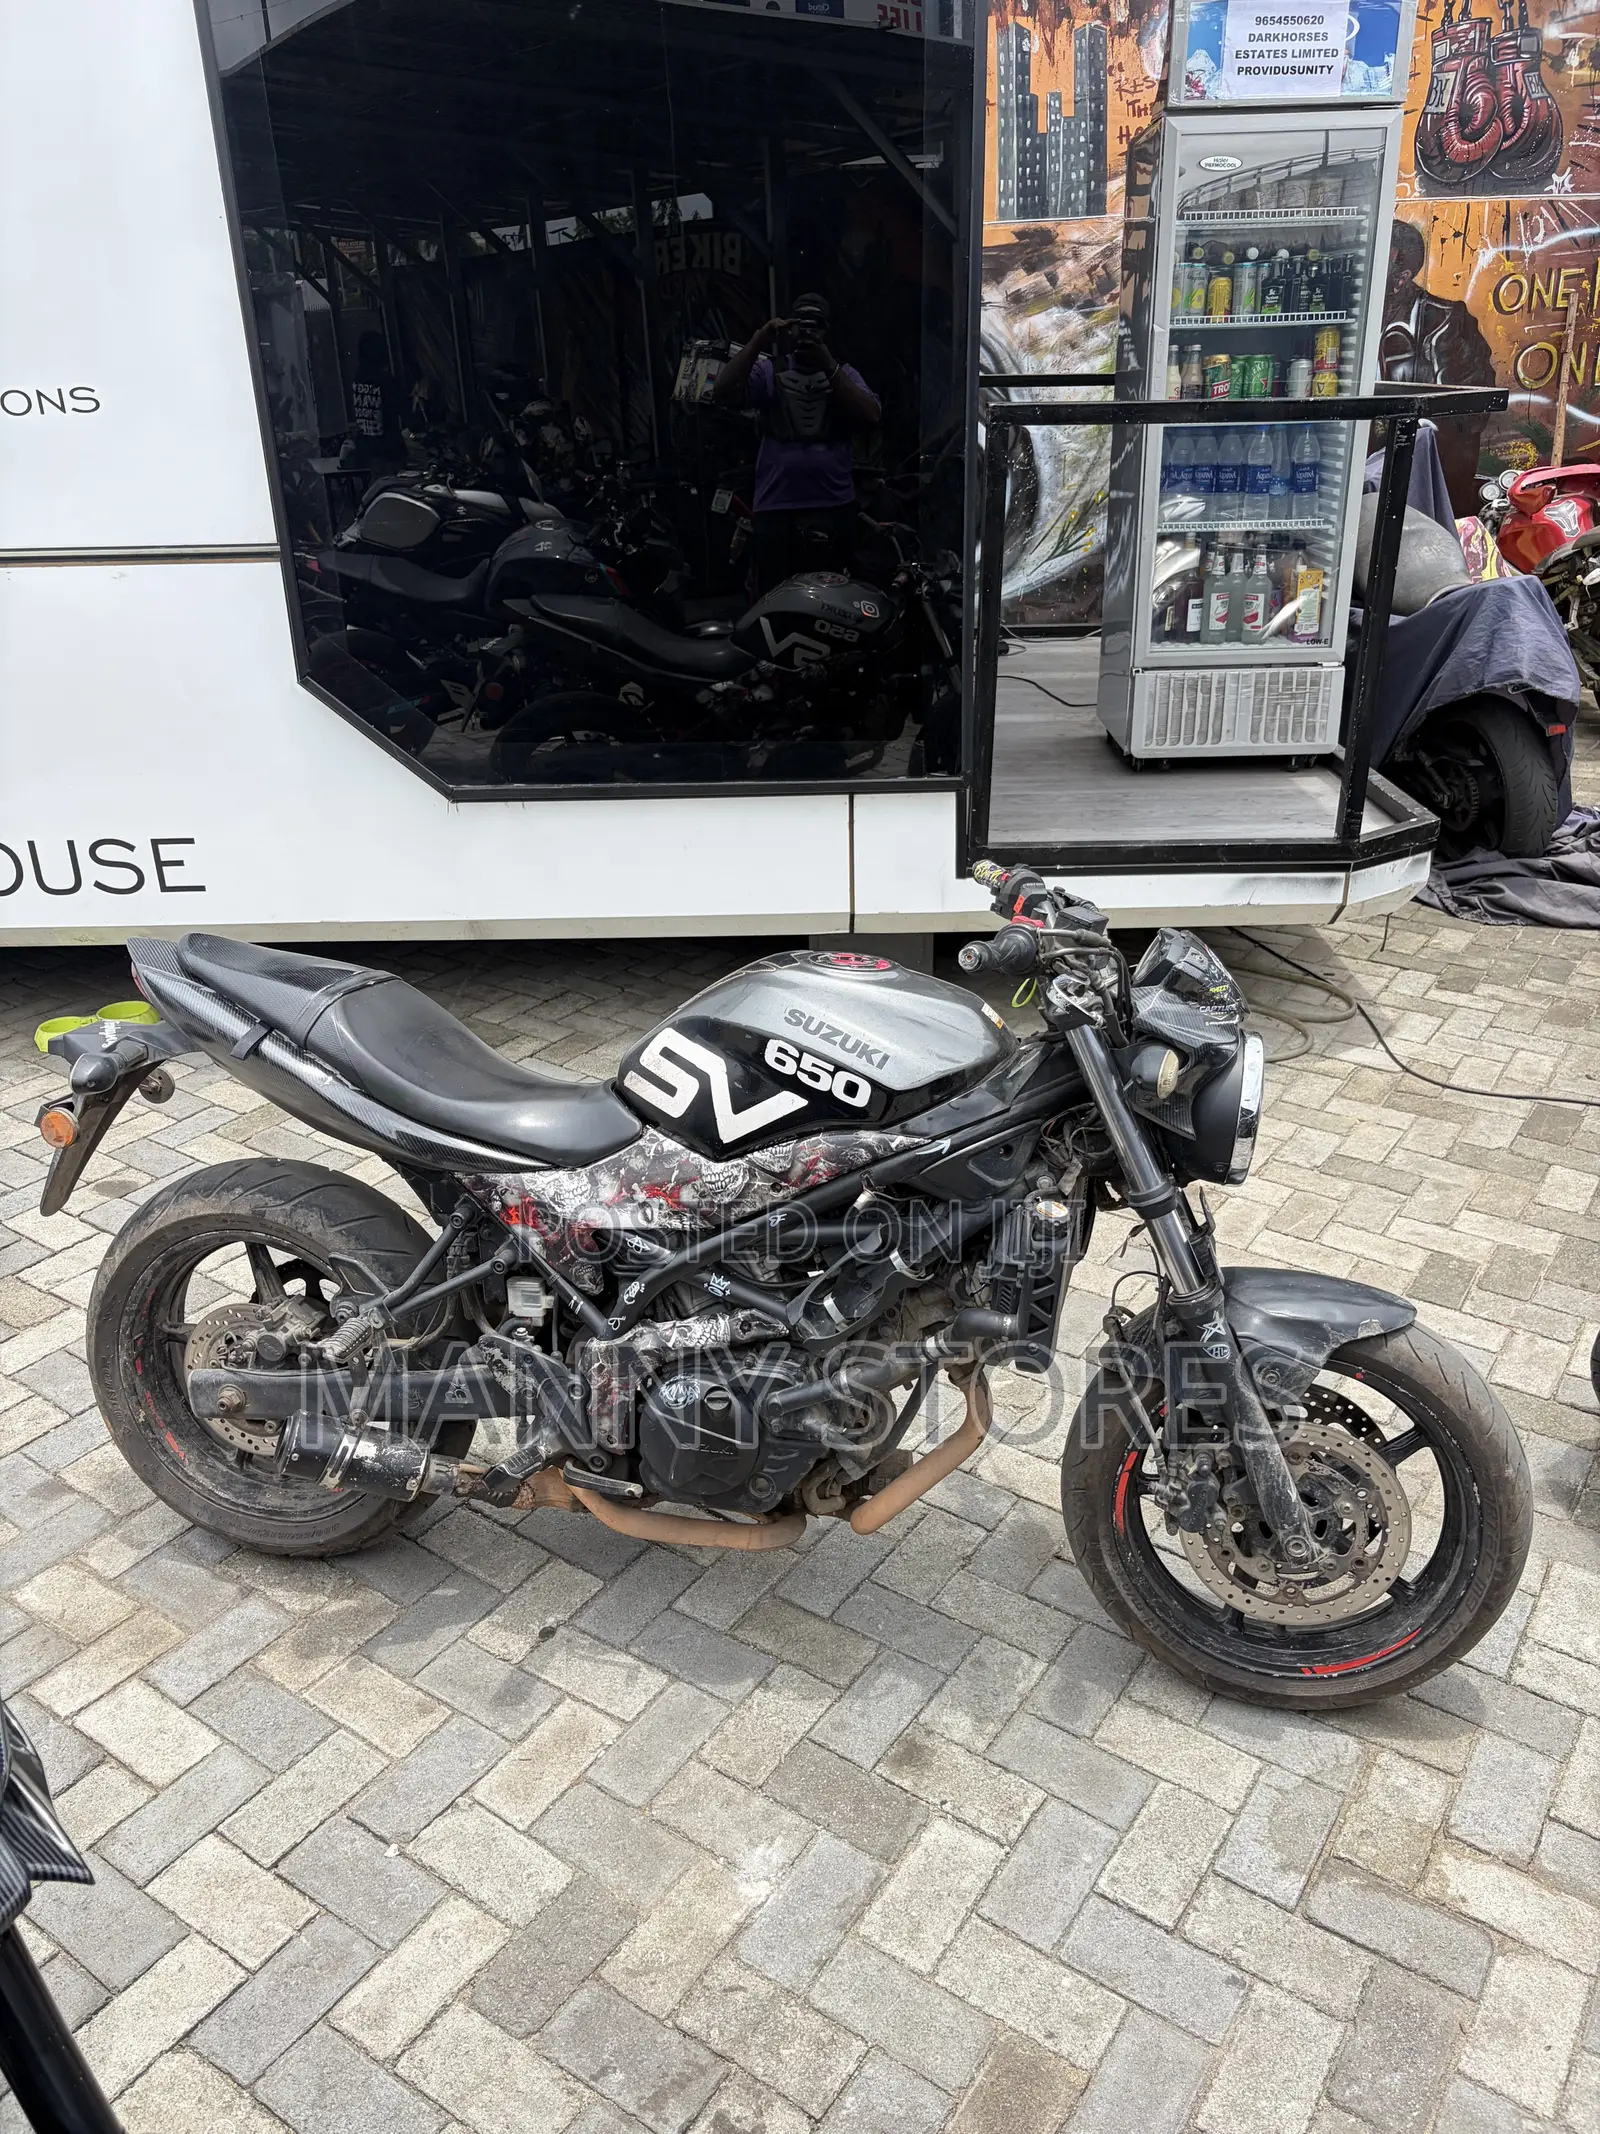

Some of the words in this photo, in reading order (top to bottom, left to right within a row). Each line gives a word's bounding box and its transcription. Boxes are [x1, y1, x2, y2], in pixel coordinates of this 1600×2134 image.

[1255, 15, 1324, 26] 9654550620
[1248, 32, 1329, 43] DARKHORSES
[1235, 49, 1288, 60] ESTATES
[1291, 48, 1339, 58] LIMITED
[1237, 65, 1335, 76] PROVIDUSUNITY
[1492, 267, 1586, 316] ONE
[0, 386, 101, 416] ONS
[784, 1008, 891, 1071] SUZUKI
[623, 1027, 809, 1144] SV
[764, 1038, 872, 1108] 650
